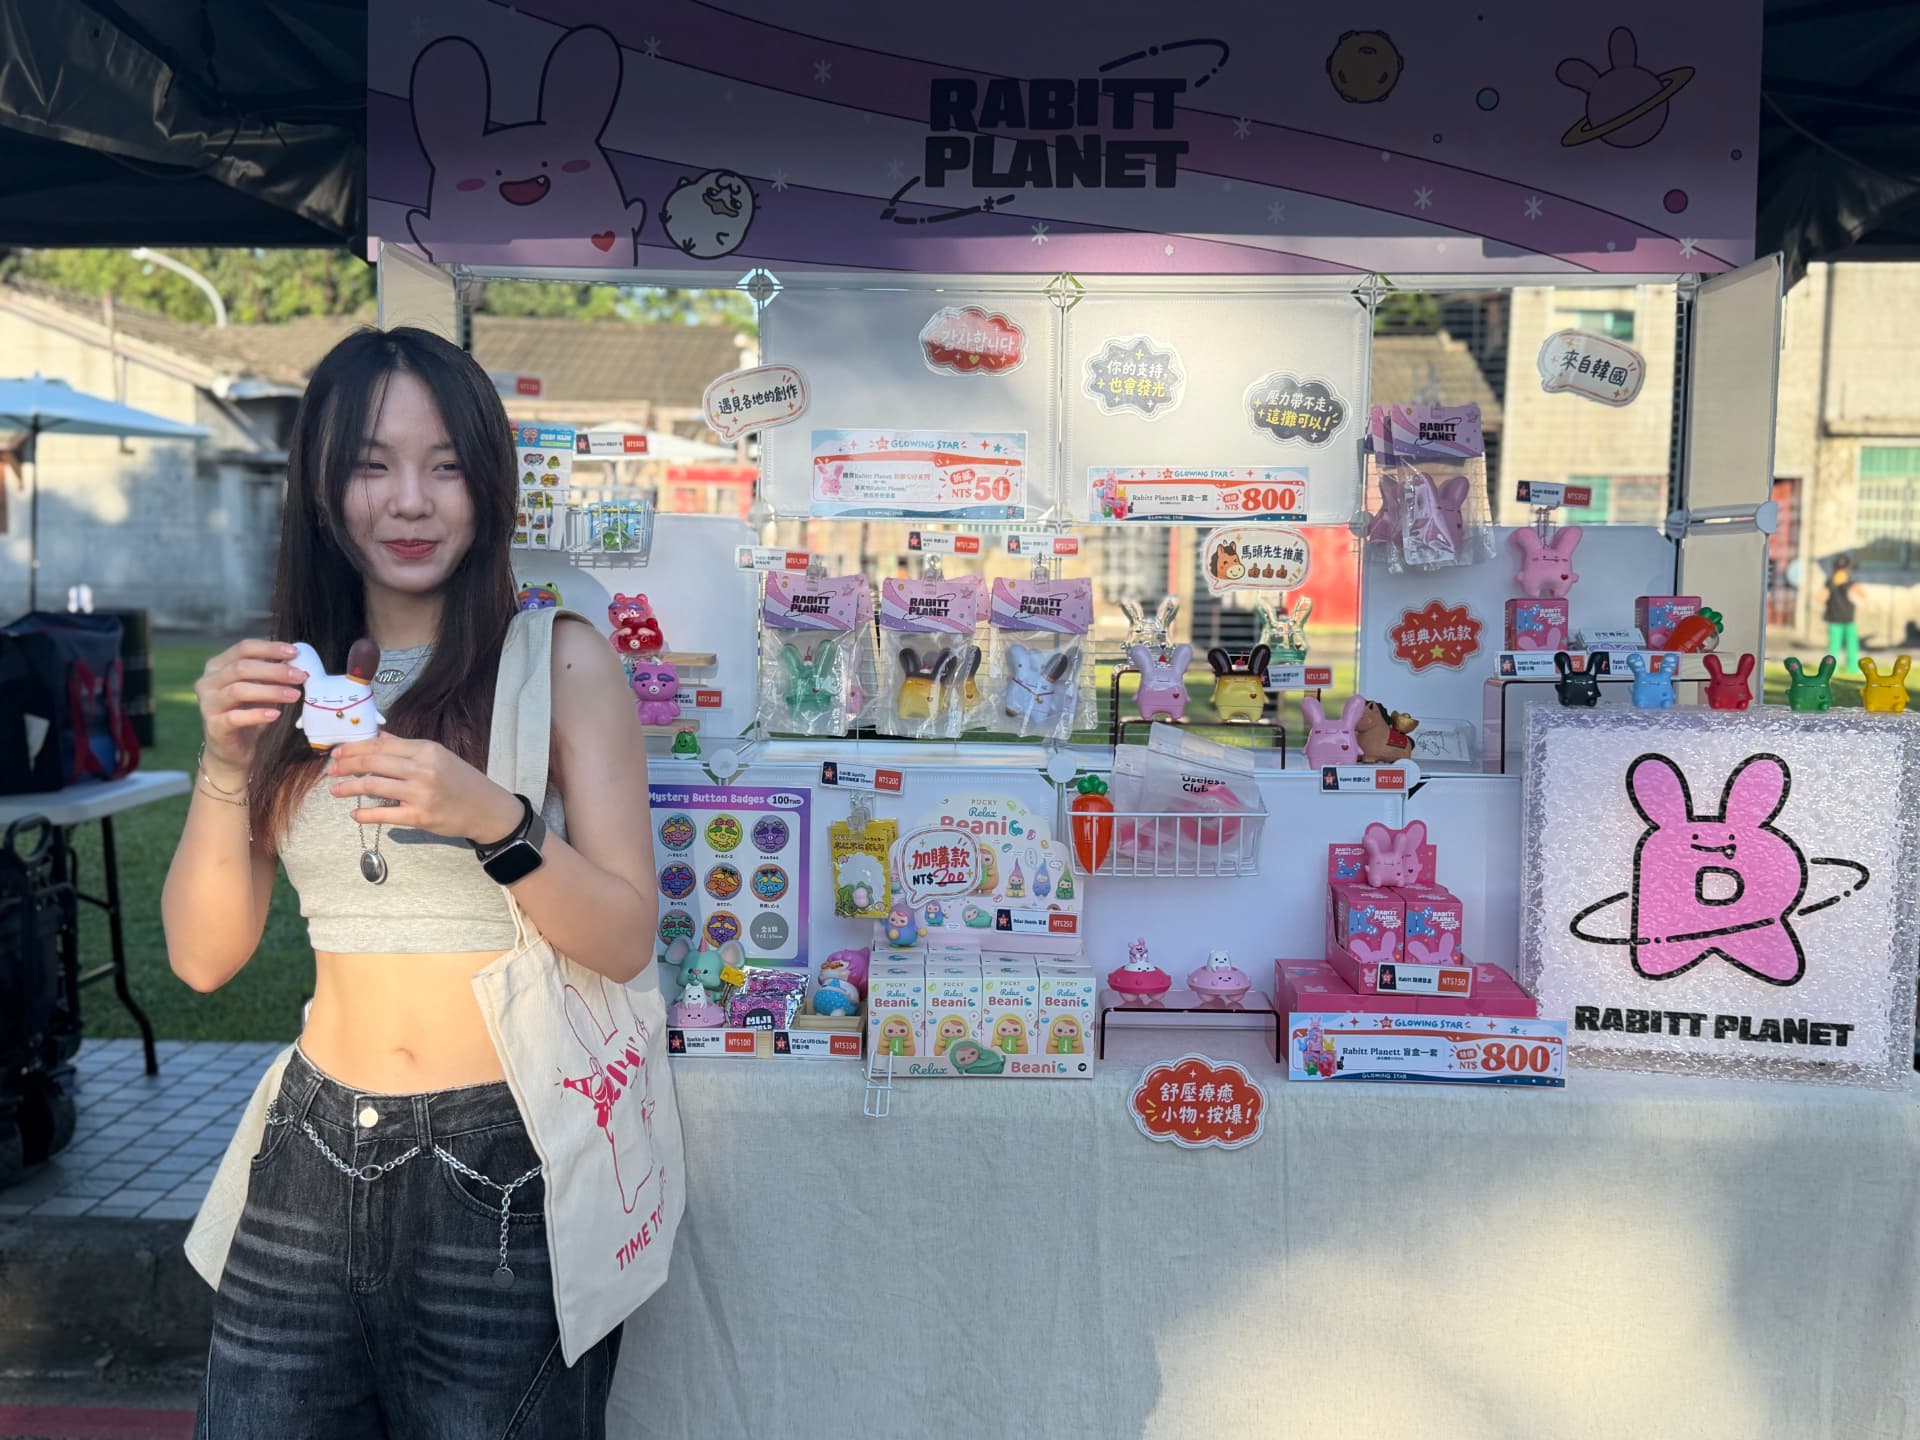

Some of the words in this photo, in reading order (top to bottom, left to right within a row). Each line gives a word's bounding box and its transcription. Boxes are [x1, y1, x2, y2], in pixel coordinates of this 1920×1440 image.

[930, 78, 1187, 131] RABITT
[925, 134, 1189, 188] PLANET
[943, 330, 1015, 352] 감사합니다
[1560, 349, 1629, 387] 來自韓國
[1110, 377, 1165, 397] 也會發光
[718, 384, 798, 415] 遇見各地的創作
[1419, 421, 1456, 432] RABITT
[1419, 432, 1457, 442] PLANET
[891, 440, 934, 449] GLOWING
[936, 440, 960, 449] STAR
[952, 488, 972, 498] NT$
[975, 476, 1011, 501] 50
[1241, 488, 1296, 511] 800
[1225, 503, 1239, 511] NT$
[1241, 544, 1304, 564] 馬頭先生推薦
[792, 595, 830, 605] RABITT
[909, 597, 949, 608] RABITT
[1021, 595, 1061, 607] RABITT
[790, 604, 829, 614] PLANET
[908, 606, 949, 617] PLANET
[1019, 604, 1061, 616] PLANET
[1401, 624, 1473, 647] 經典入坑款
[1182, 783, 1208, 793] Club
[649, 791, 689, 803] Mystery
[692, 792, 727, 803] Button
[731, 794, 765, 805] Badges
[969, 807, 997, 817] Relax
[911, 847, 970, 870] 加購款
[912, 873, 934, 885] NT$
[1000, 988, 1020, 996] Relax
[1057, 989, 1076, 997] Relax
[1395, 1019, 1438, 1028] GLOWING
[1440, 1020, 1464, 1029] STAR
[1574, 1005, 1707, 1036] RABITT
[1713, 1014, 1855, 1047] PLANET
[728, 1038, 751, 1047] NT$100
[1370, 1048, 1401, 1056] Planett
[1404, 1048, 1438, 1057] 盲盒一套
[1481, 1043, 1550, 1072] 800
[909, 1063, 947, 1075] Relax
[1459, 1061, 1478, 1070] NT$
[1160, 1082, 1234, 1103] 舒壓療癒
[616, 1222, 651, 1271] TIME
